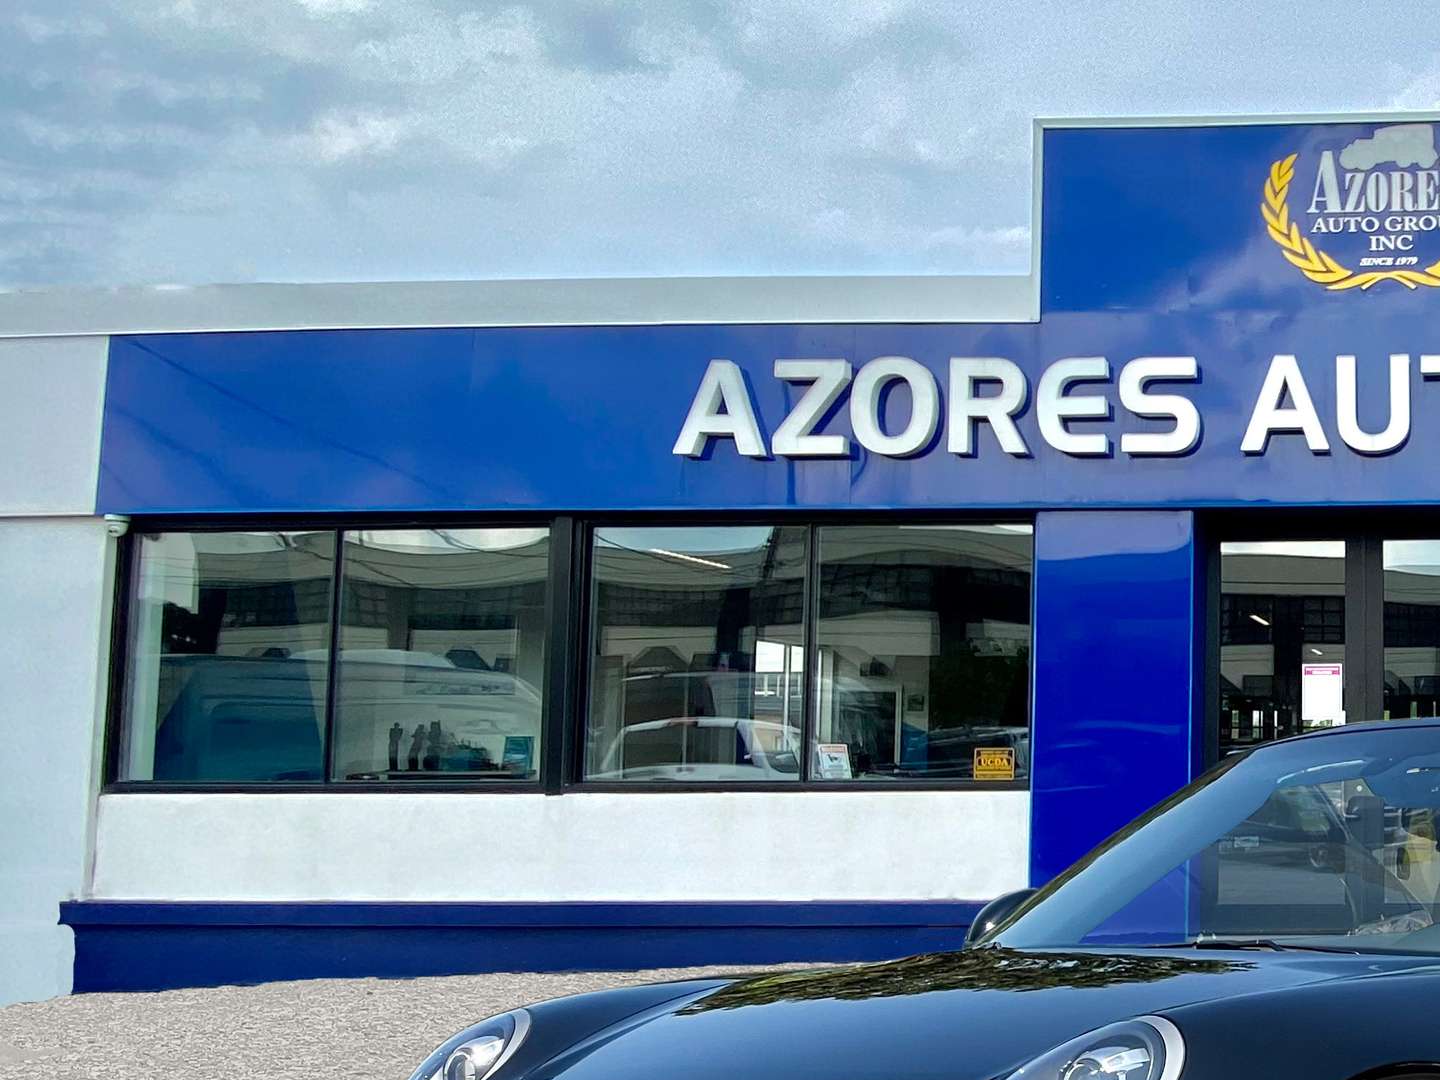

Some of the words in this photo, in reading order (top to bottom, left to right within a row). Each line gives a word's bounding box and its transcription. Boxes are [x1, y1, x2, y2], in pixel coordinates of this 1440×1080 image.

[1311, 216, 1380, 233] AUTO
[1369, 234, 1414, 251] INC
[1360, 257, 1394, 266] SINCE
[1395, 256, 1418, 265] 1979
[672, 355, 1202, 459] AZORES
[980, 757, 1009, 767] UCDA
